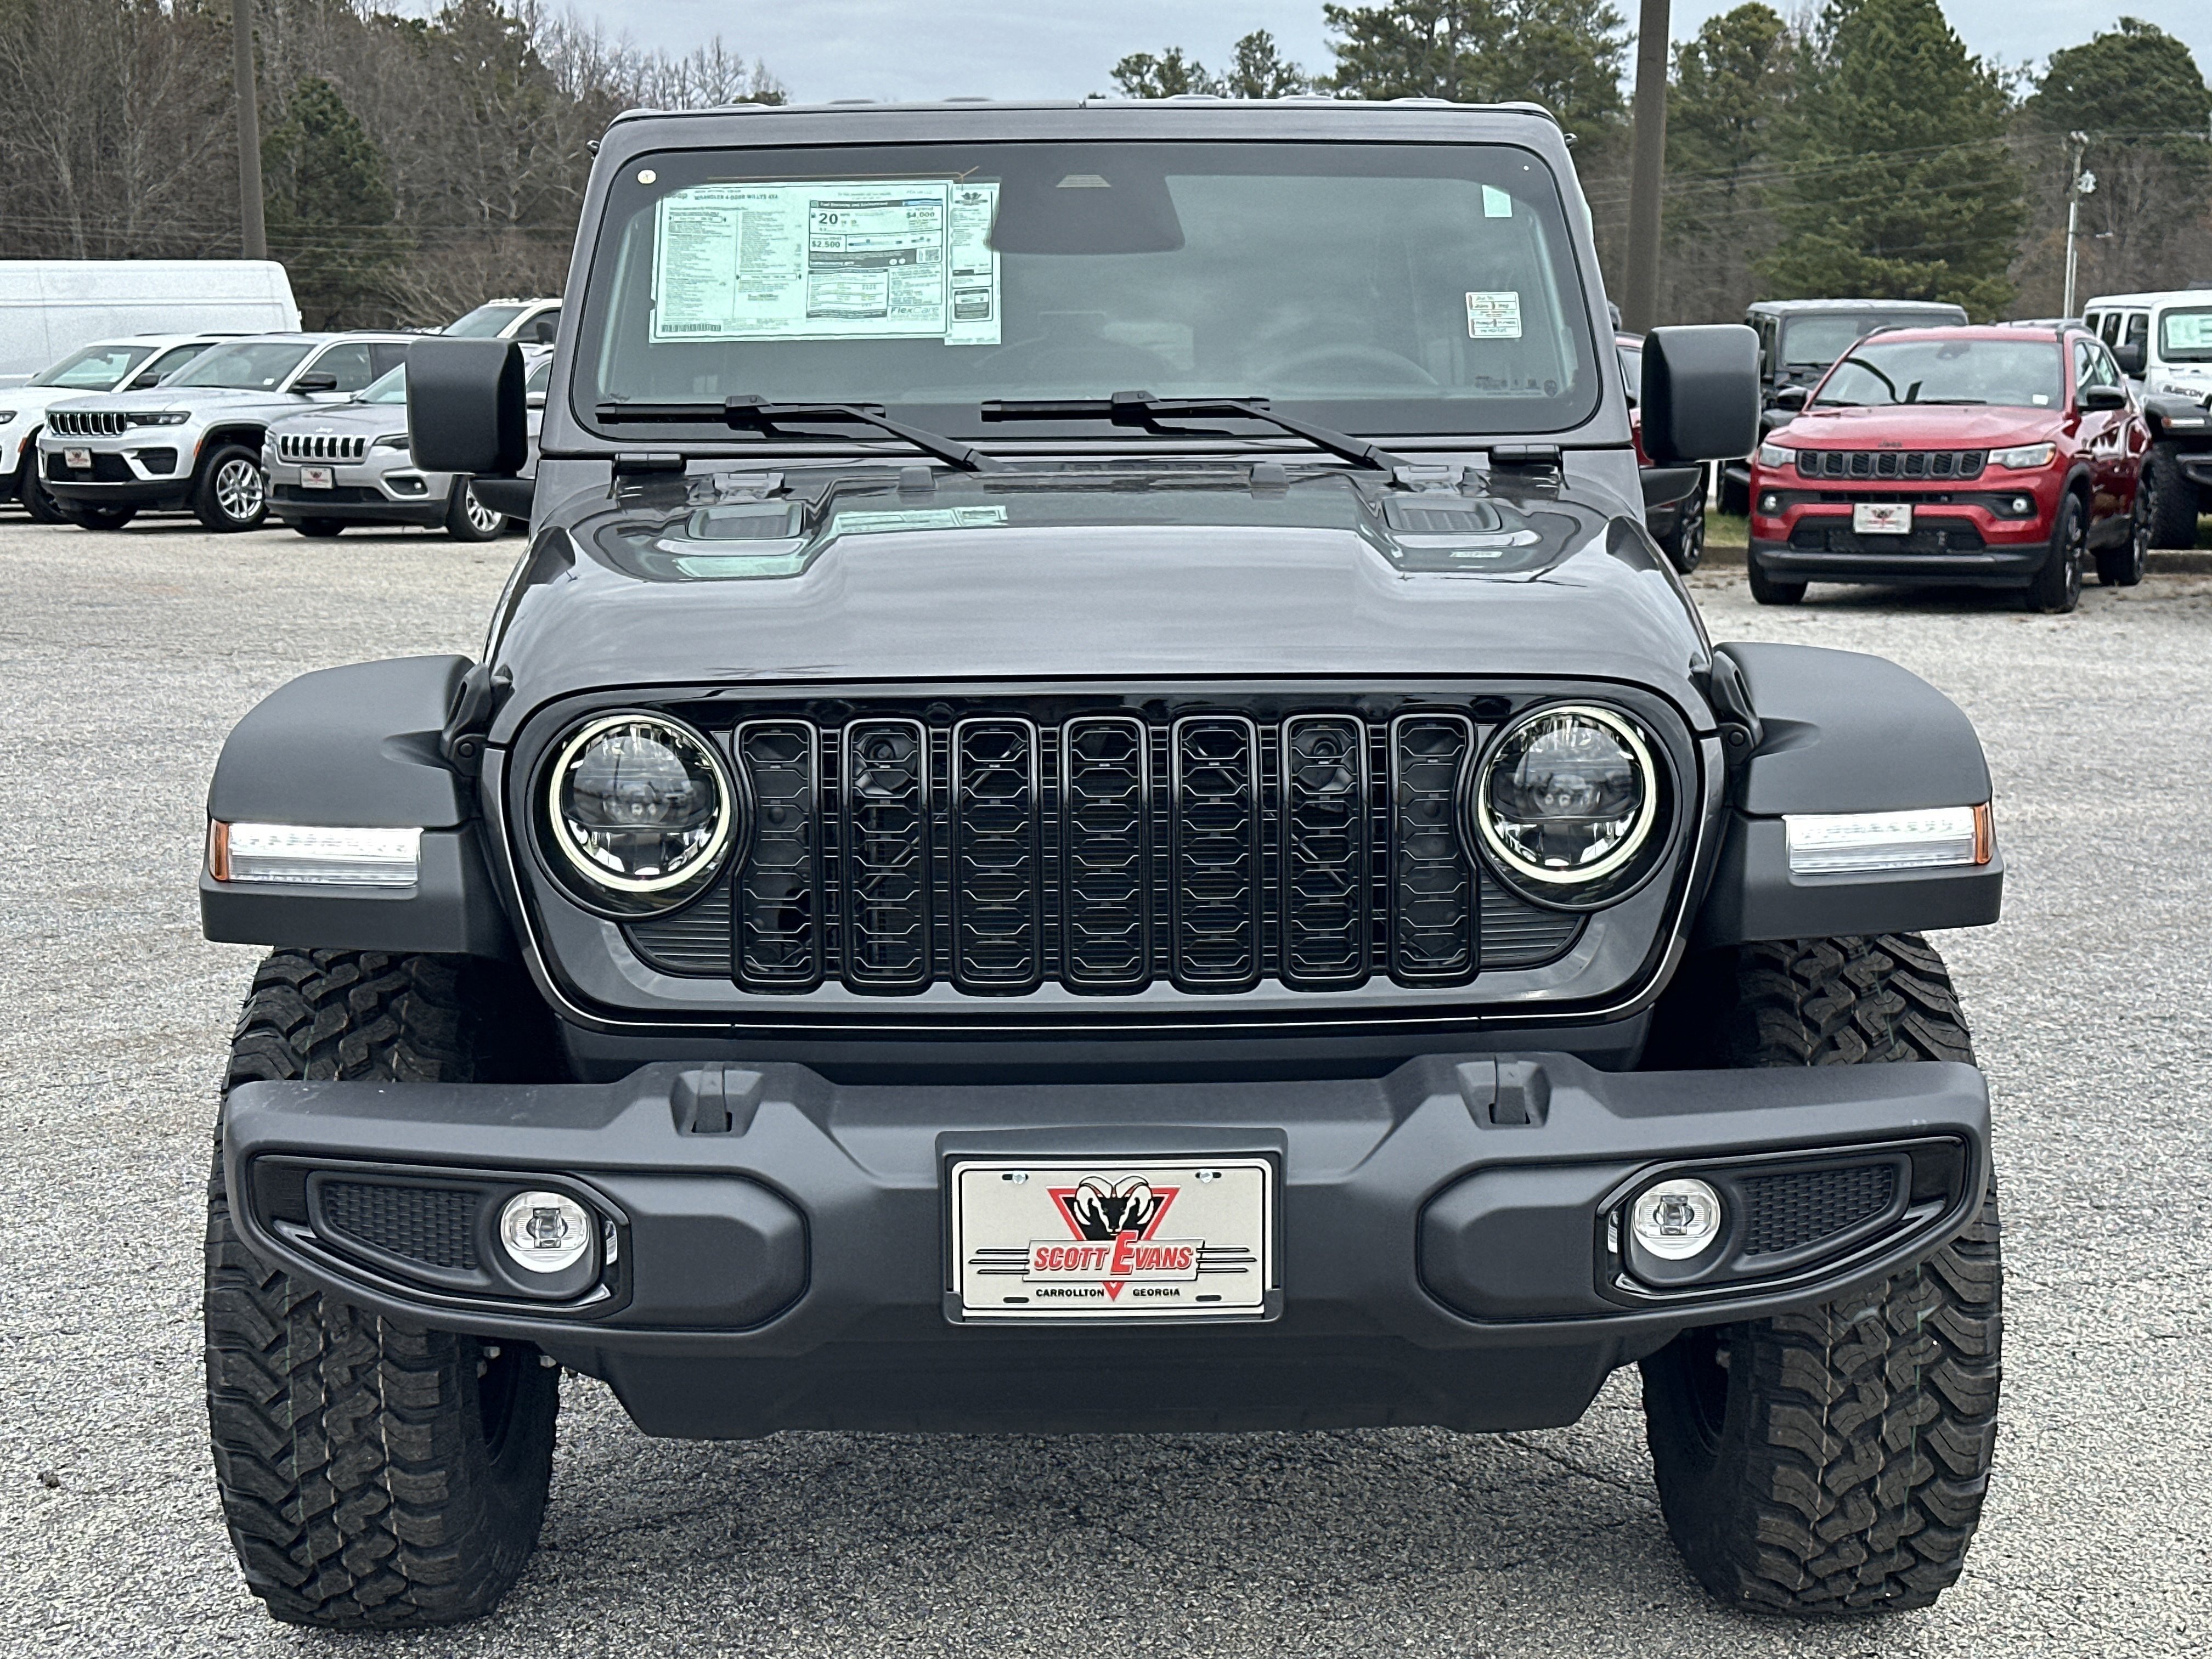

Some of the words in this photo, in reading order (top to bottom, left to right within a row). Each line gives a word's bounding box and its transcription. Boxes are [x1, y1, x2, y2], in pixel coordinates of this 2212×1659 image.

[819, 213, 838, 225] 20
[1034, 1246, 1109, 1272] SCOTT
[1110, 1229, 1194, 1276] EVANS
[1036, 1288, 1105, 1298] CARROLLTON
[1132, 1288, 1181, 1297] GEORGIA
